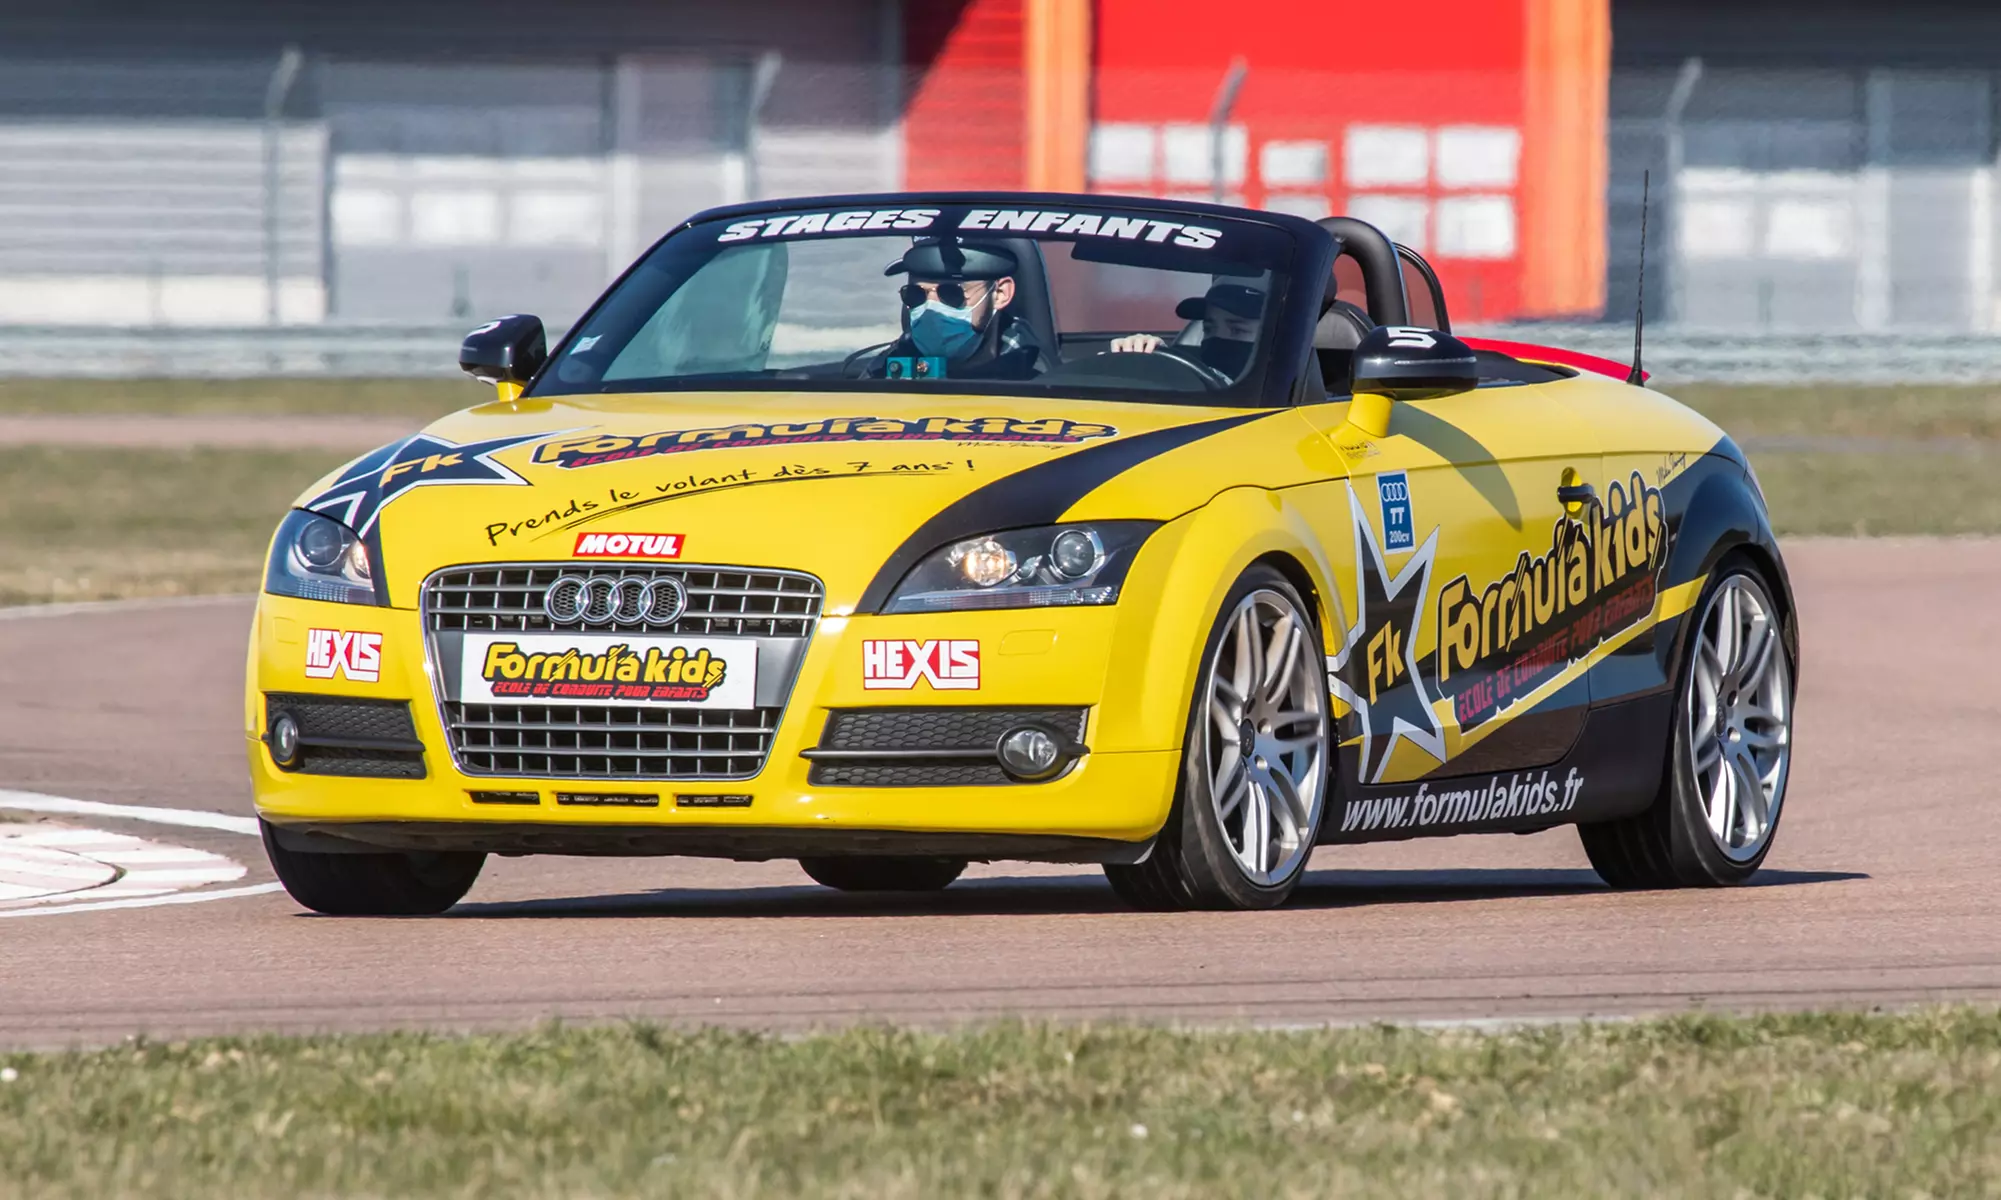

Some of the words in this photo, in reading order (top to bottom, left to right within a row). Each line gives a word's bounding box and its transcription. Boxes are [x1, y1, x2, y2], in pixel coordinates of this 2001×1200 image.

[718, 209, 941, 242] STAGES
[958, 210, 1222, 249] ENFANTS
[1386, 327, 1437, 348] 5
[541, 418, 905, 462] Formula
[924, 418, 1107, 437] kids
[485, 500, 599, 546] Prends
[610, 489, 640, 502] le
[656, 469, 757, 492] volant
[773, 464, 830, 477] dès
[847, 461, 872, 472] 7
[966, 459, 976, 471] !
[1390, 507, 1405, 525] TT
[577, 534, 677, 555] MOTUL
[1441, 516, 1588, 683] Formula
[1592, 475, 1662, 594] kids
[305, 628, 383, 683] HEXIS
[484, 643, 640, 682] Formula
[643, 647, 723, 688] kids
[863, 639, 980, 690] HEXIS
[494, 681, 531, 694] ECOLE
[533, 683, 550, 694] DE
[550, 683, 612, 696] CONDUITE
[615, 685, 650, 697] POUR
[1340, 767, 1584, 832] www.formulakids.fr
